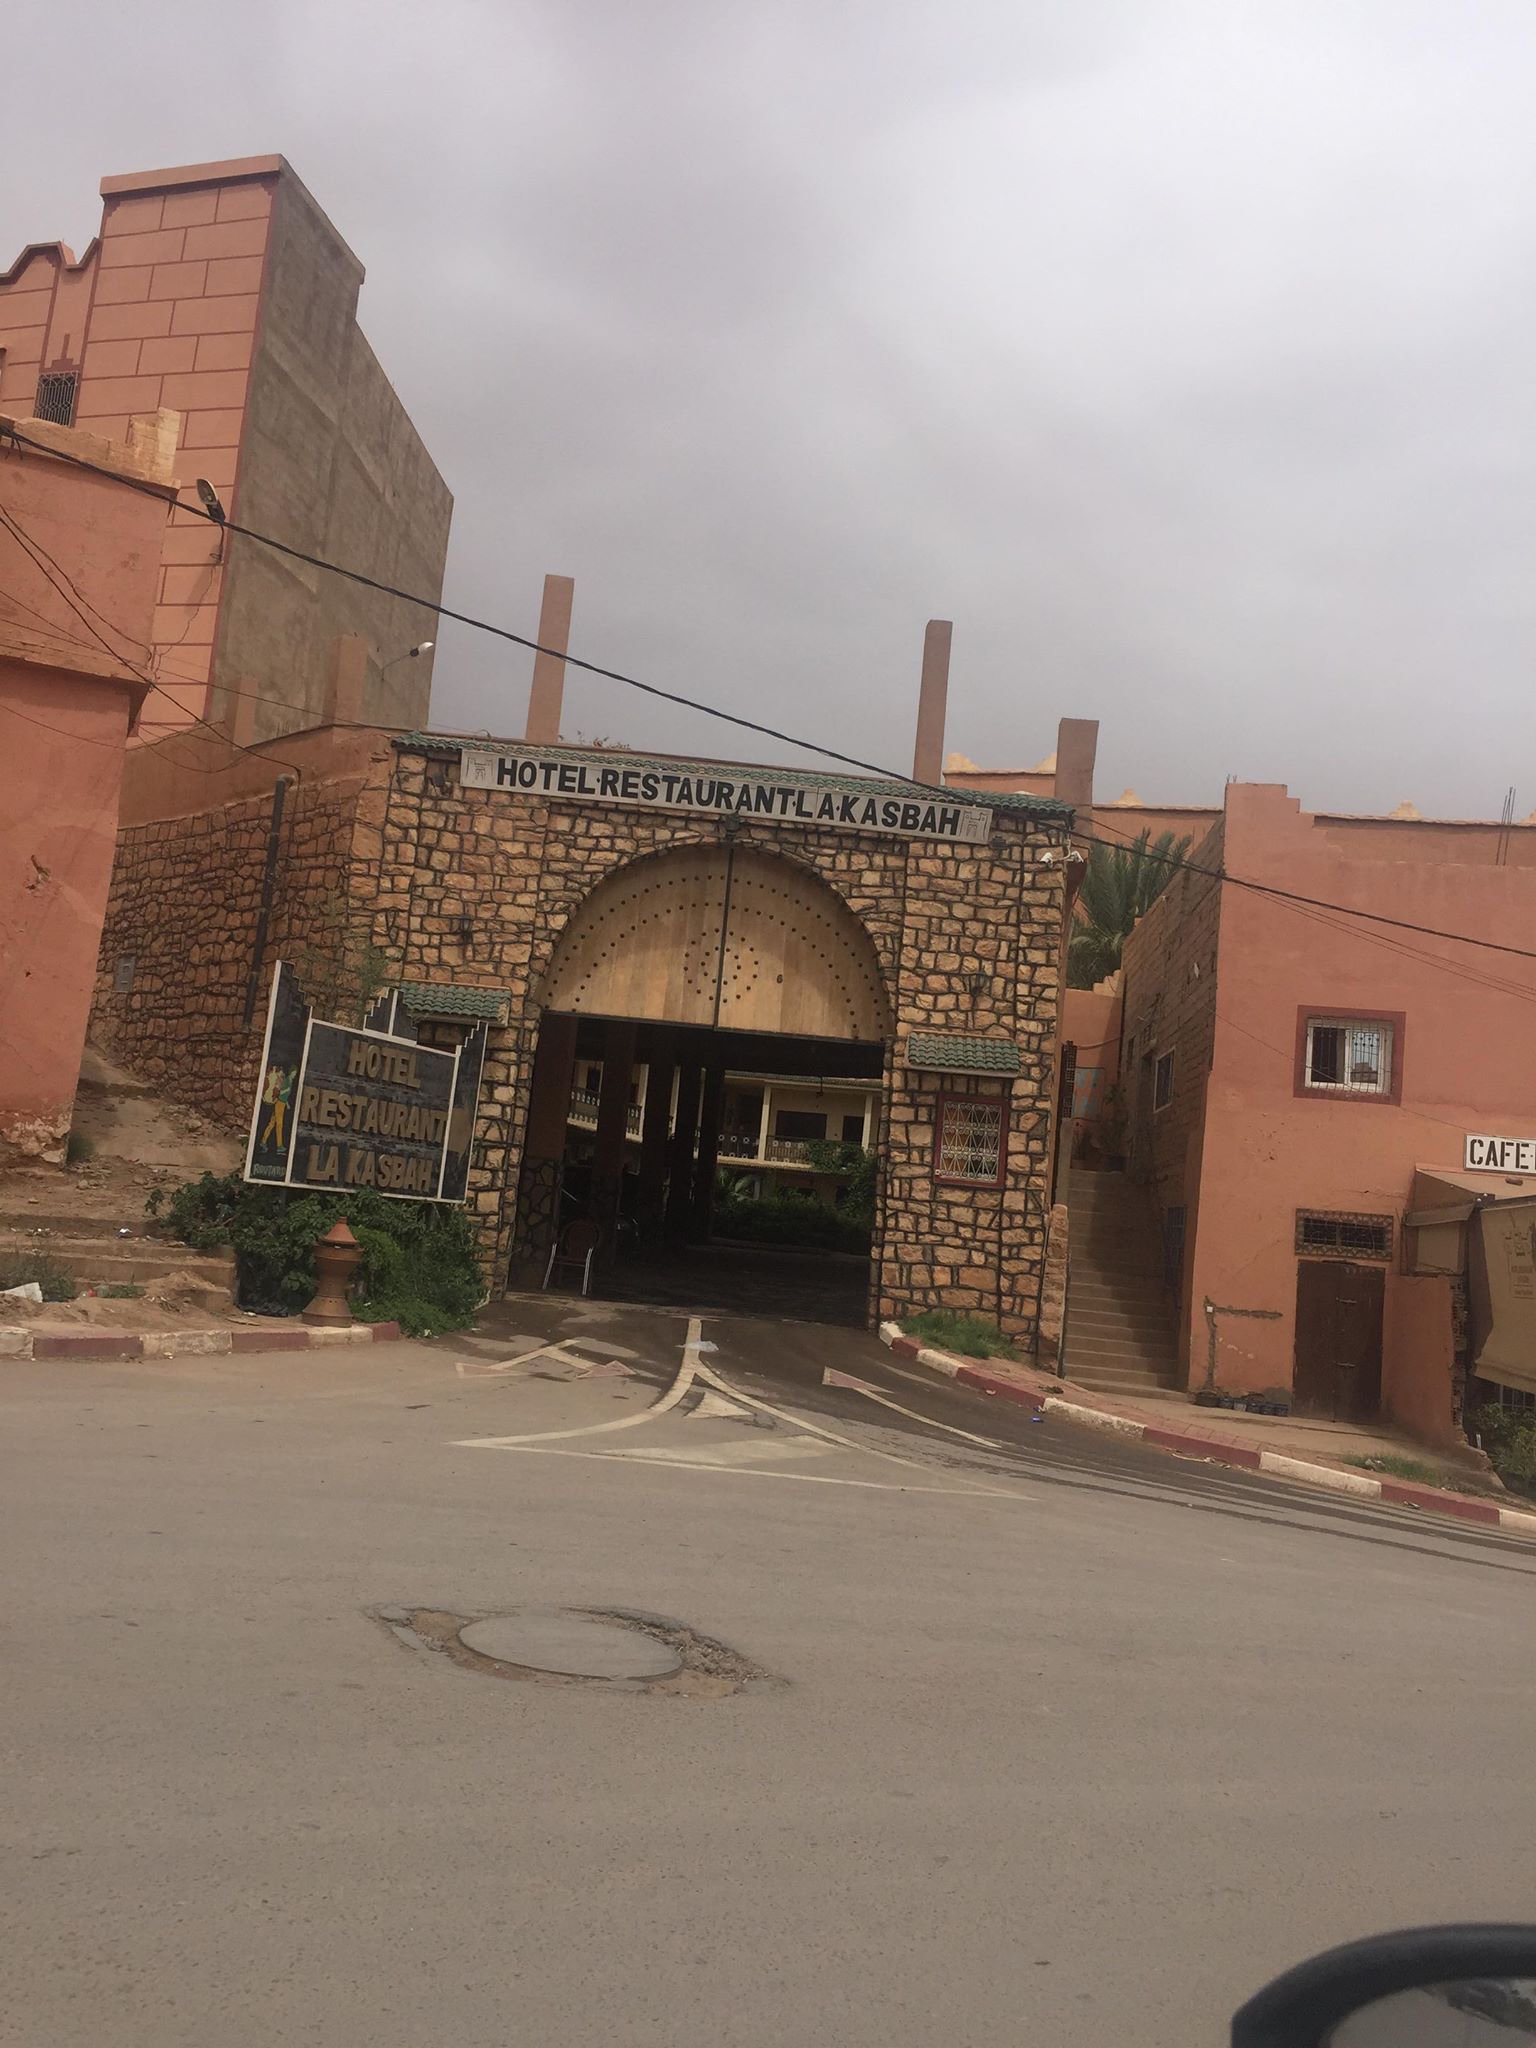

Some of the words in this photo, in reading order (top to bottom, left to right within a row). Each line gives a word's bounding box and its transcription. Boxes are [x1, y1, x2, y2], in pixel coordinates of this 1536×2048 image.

[497, 758, 596, 794] HOTEL
[600, 768, 796, 816] RESTAURANT
[795, 790, 835, 820] LA
[839, 795, 961, 836] KASBAH
[347, 1039, 421, 1089] HOTEL
[300, 1086, 449, 1144] RESTAURANT
[306, 1144, 339, 1182] LA
[344, 1150, 433, 1193] KASBAH
